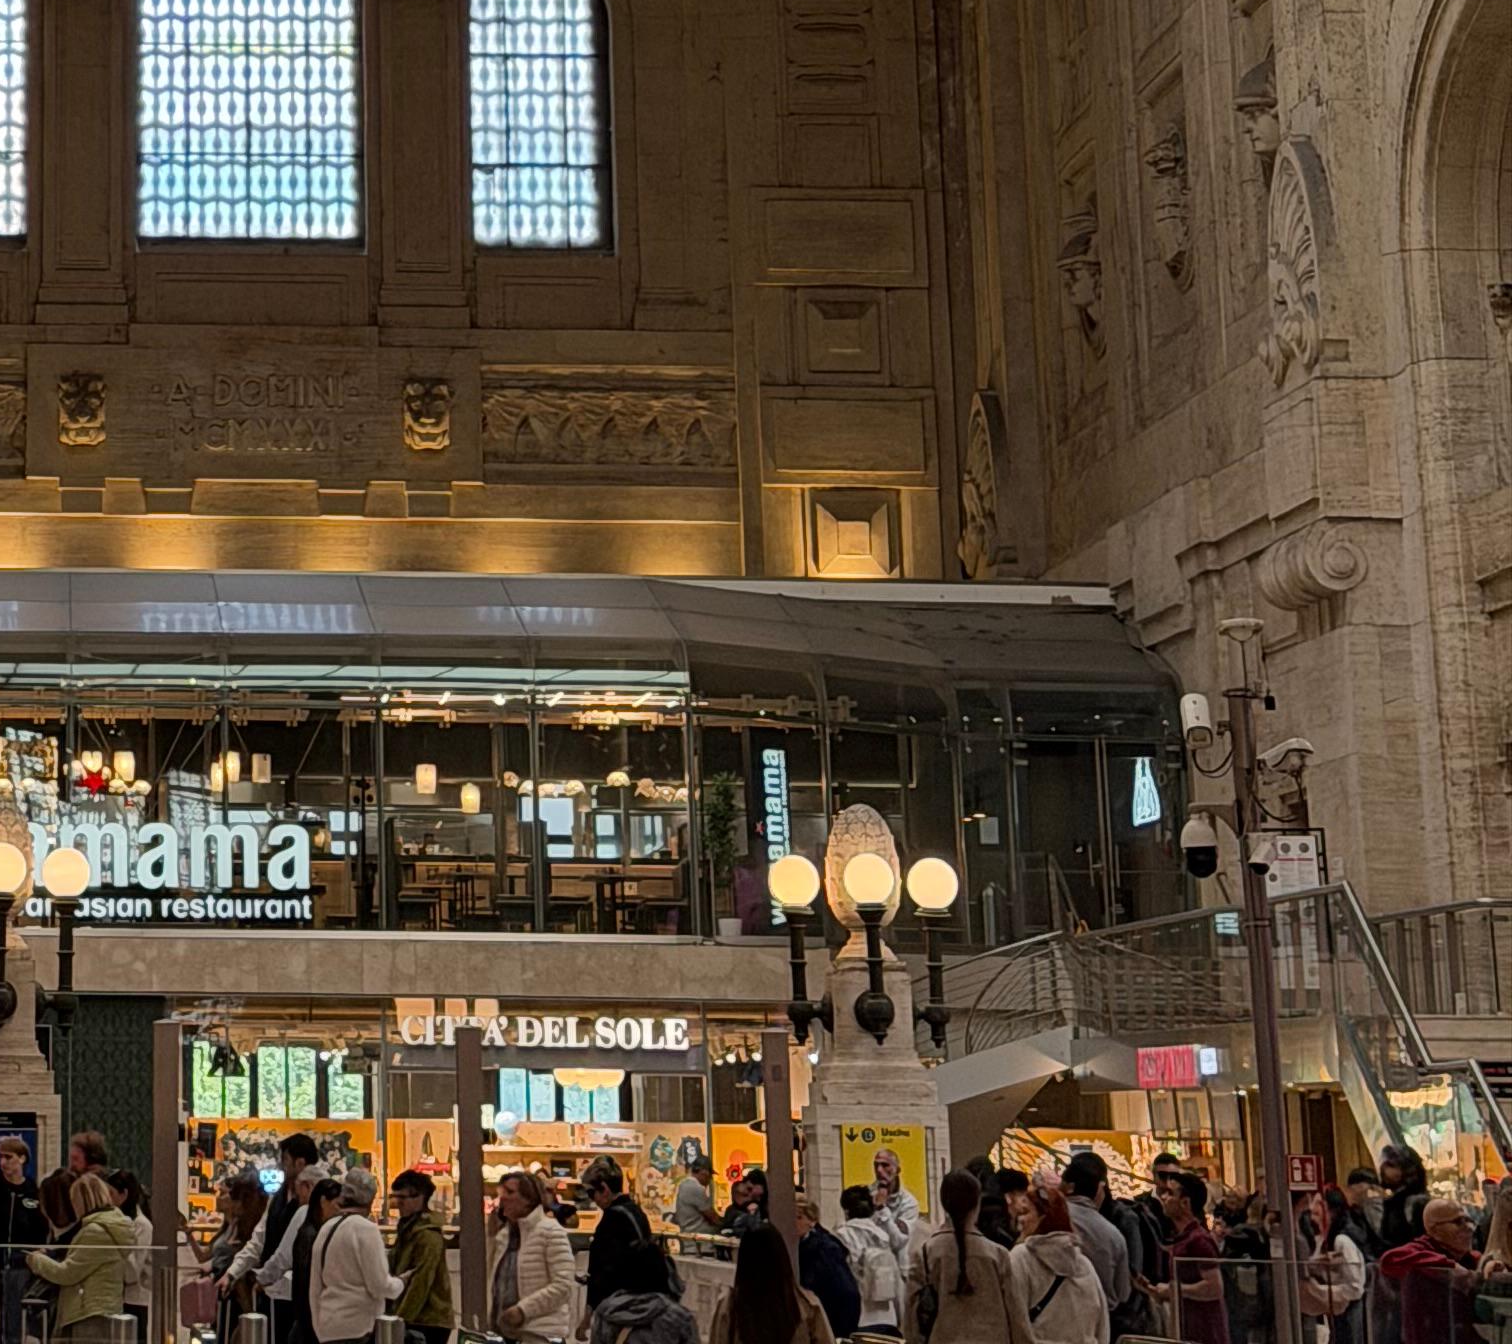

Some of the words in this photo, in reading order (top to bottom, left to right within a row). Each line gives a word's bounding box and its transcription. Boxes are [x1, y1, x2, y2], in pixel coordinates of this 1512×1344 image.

[212, 374, 345, 409] DOMINI
[161, 894, 312, 920] restaurant
[516, 1016, 589, 1048] DEL
[594, 1017, 689, 1051] SOLE
